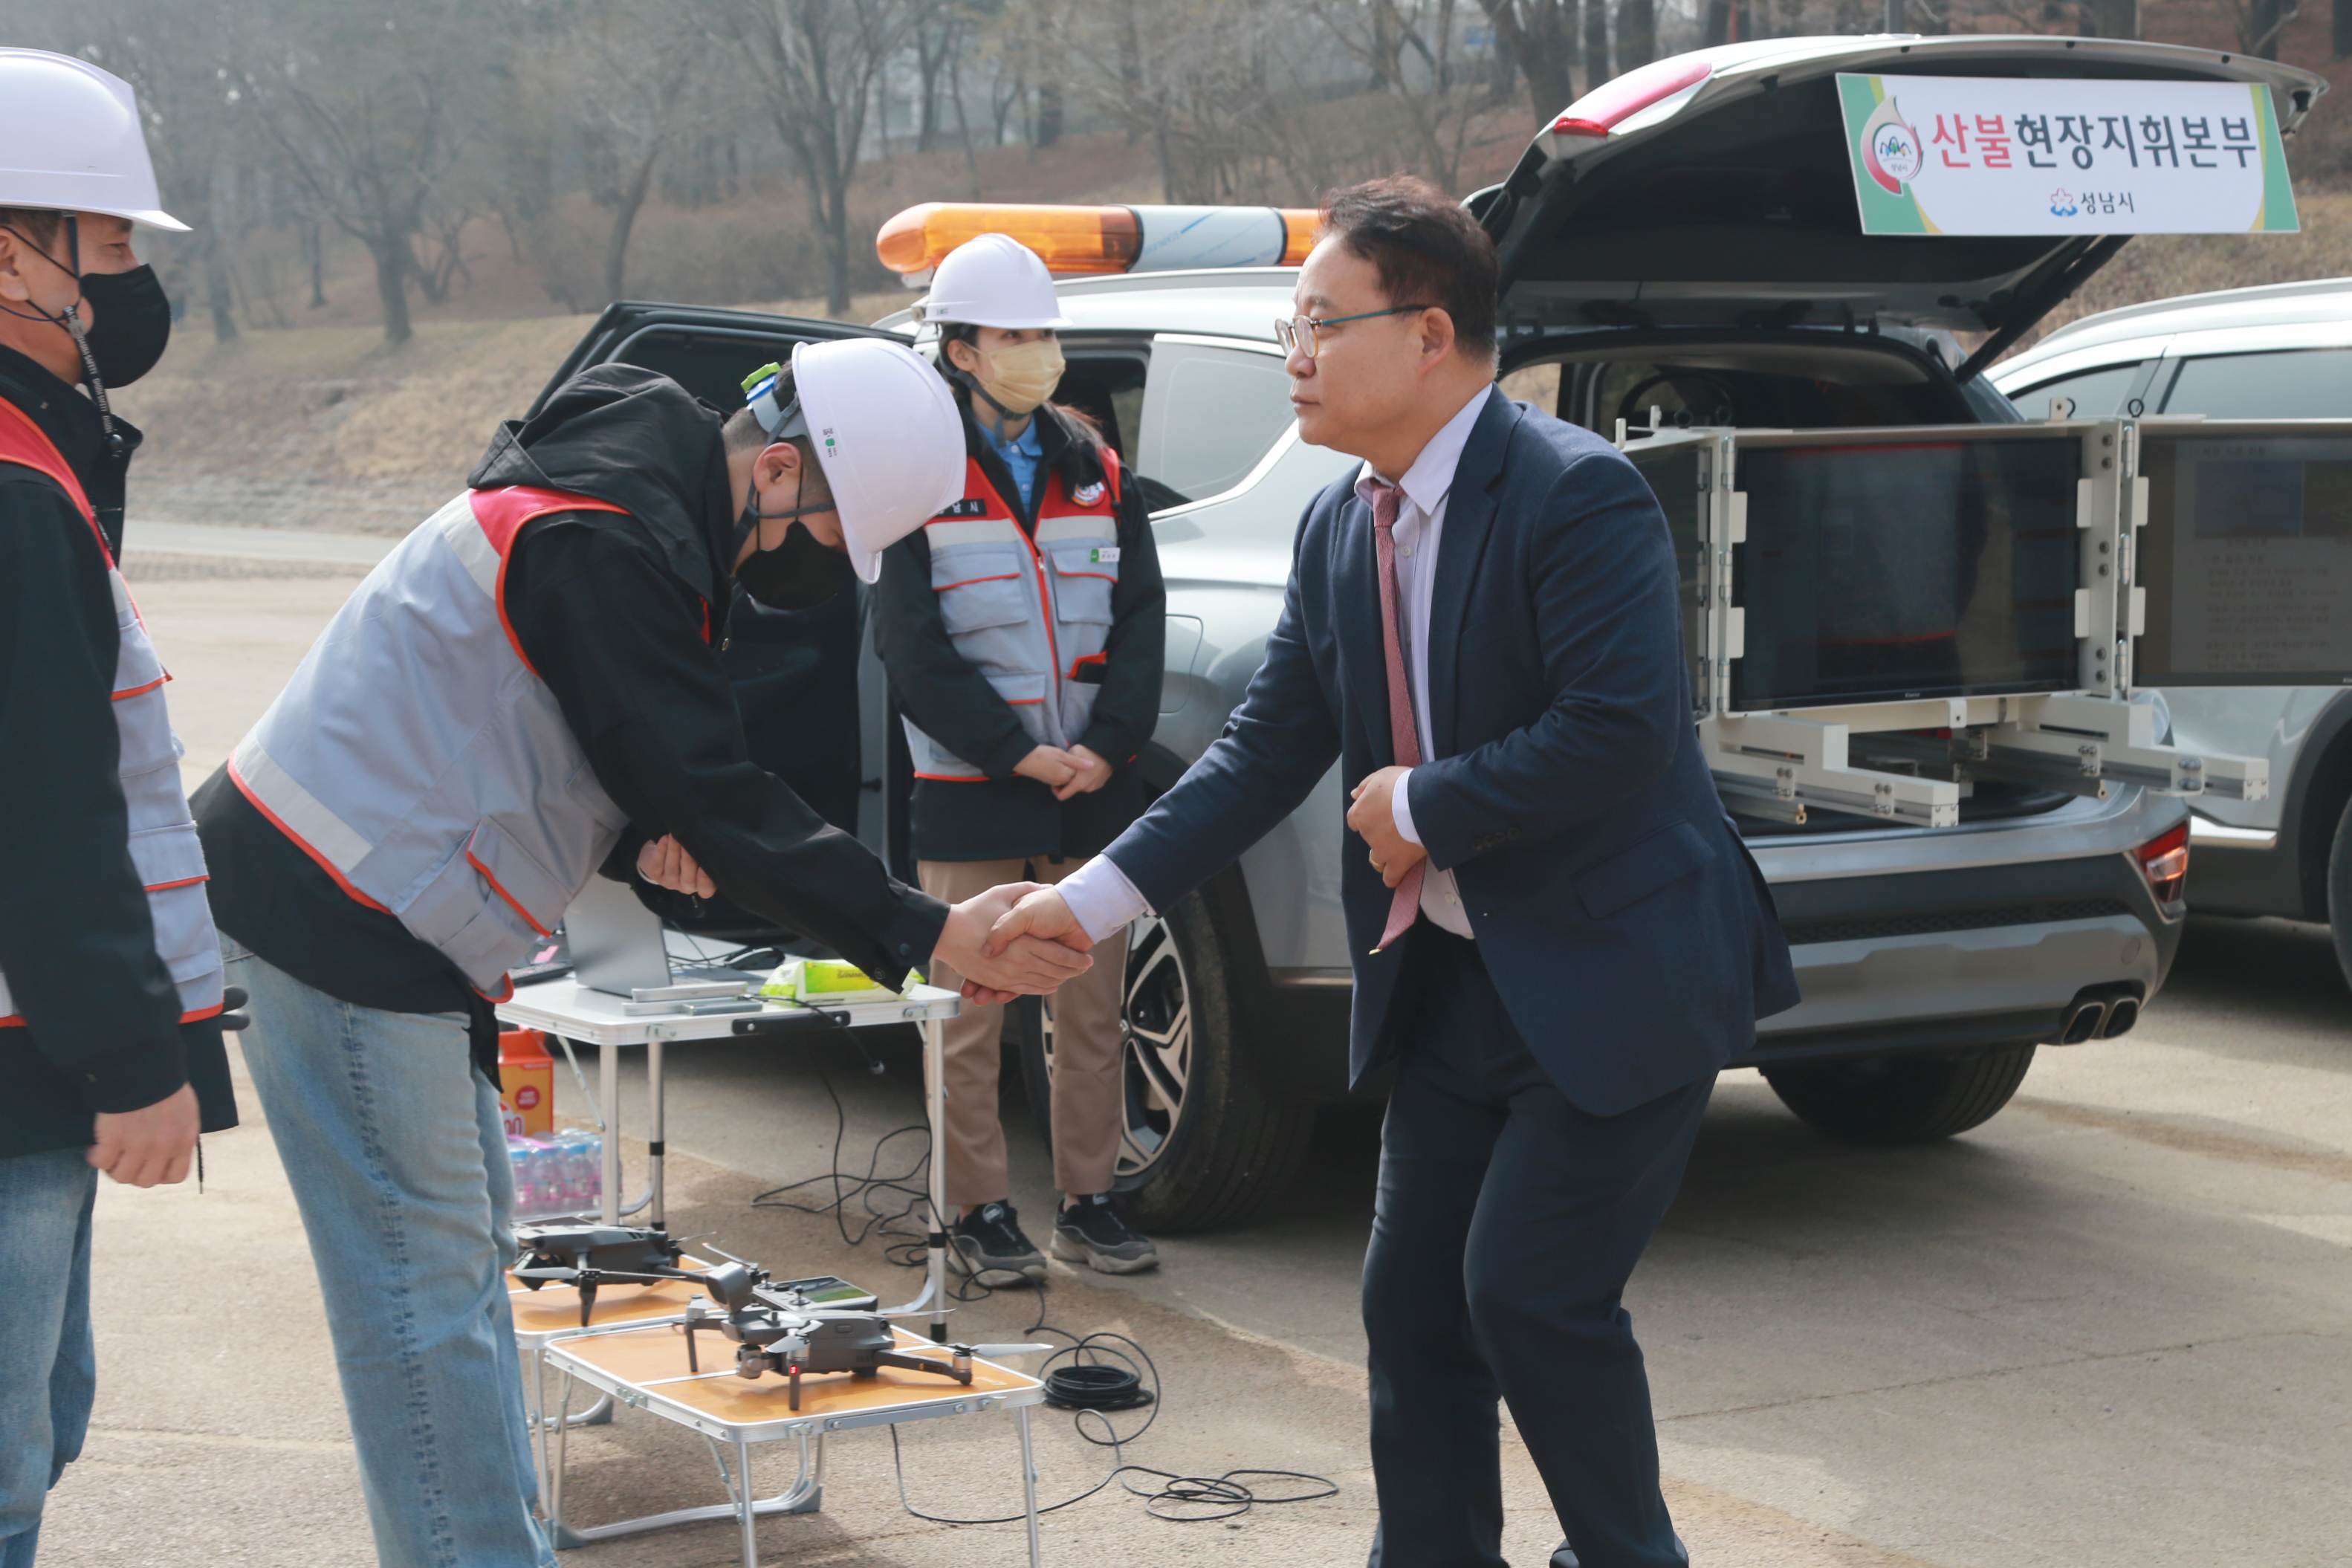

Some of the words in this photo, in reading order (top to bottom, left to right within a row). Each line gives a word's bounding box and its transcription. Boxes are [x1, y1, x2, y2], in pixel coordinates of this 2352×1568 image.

[1931, 113, 2257, 170] 산불현장지휘본부
[2081, 192, 2135, 215] 성남시
[84, 354, 97, 374] SAFETY
[97, 395, 108, 412] SAFETY
[939, 501, 978, 514] 남시
